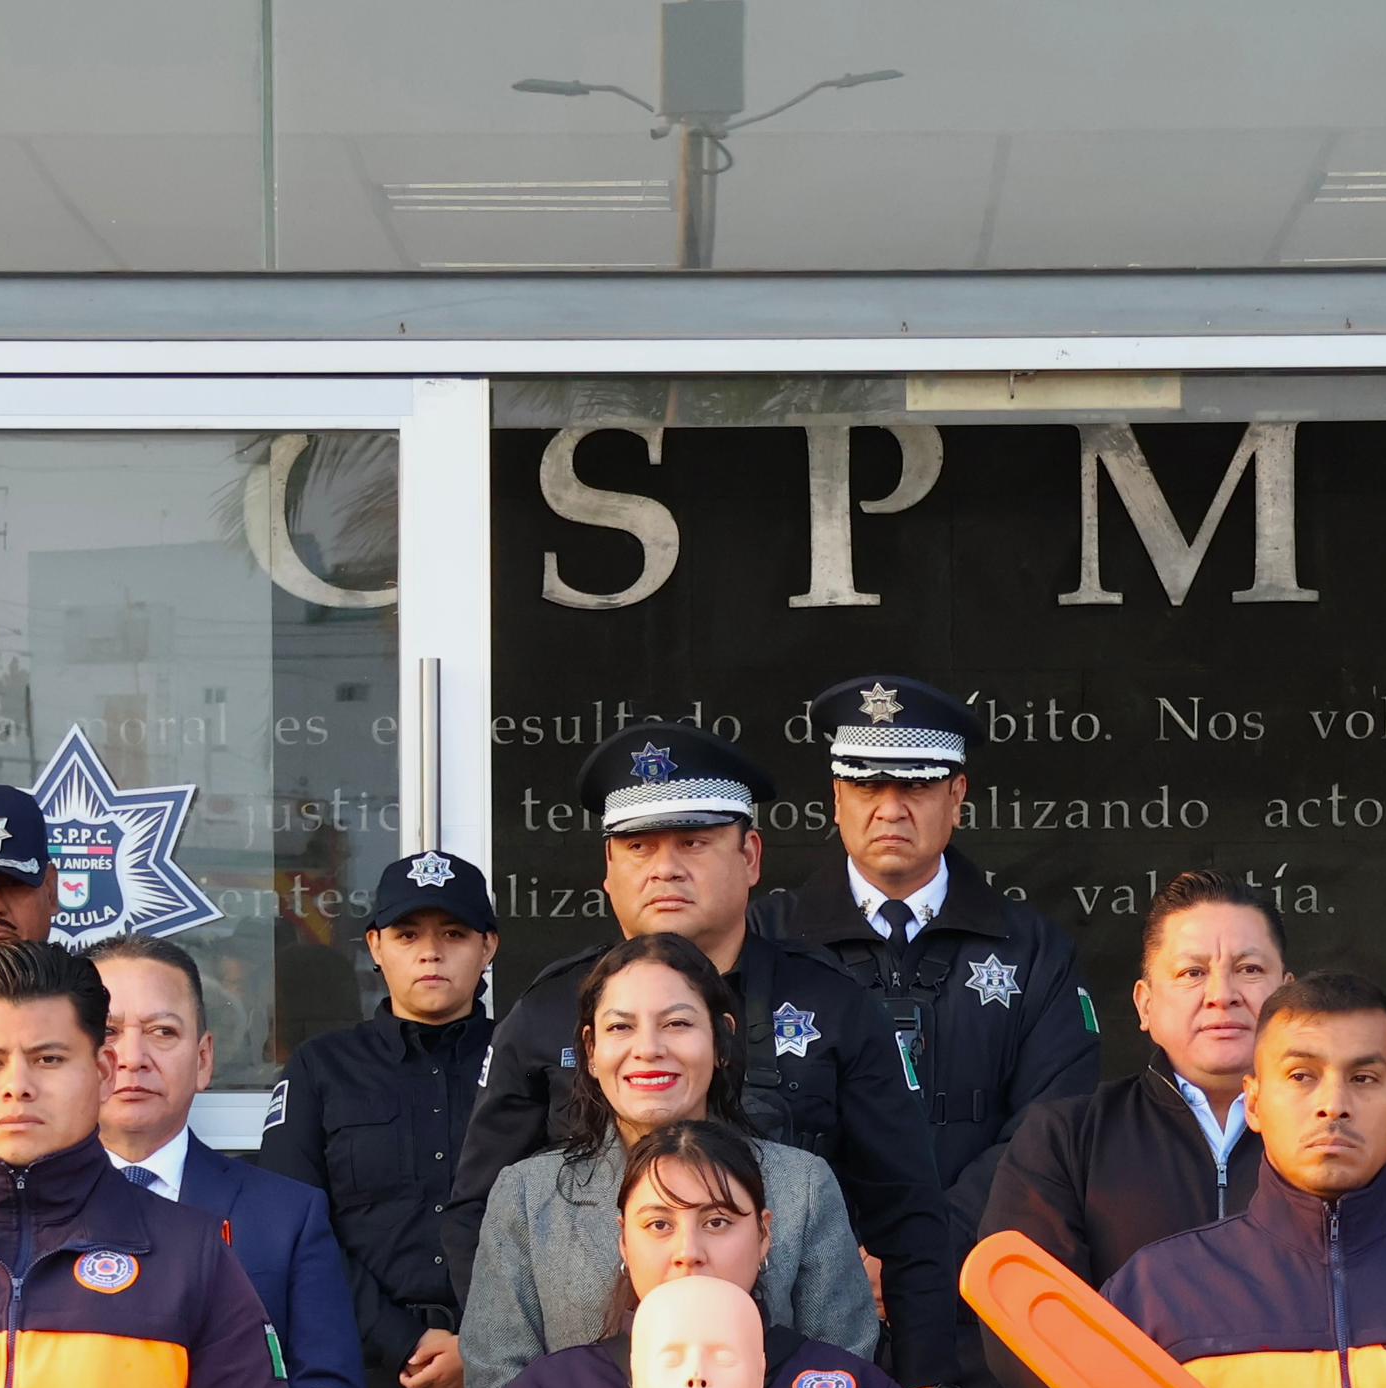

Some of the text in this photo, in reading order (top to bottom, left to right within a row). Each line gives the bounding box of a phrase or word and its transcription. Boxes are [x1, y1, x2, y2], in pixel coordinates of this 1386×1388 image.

[273, 715, 330, 747] es
[1154, 696, 1266, 742] Nos
[47, 827, 112, 845] .S.P.P.C.
[63, 855, 113, 870] ANDRÉS
[50, 904, 118, 927] OLULA
